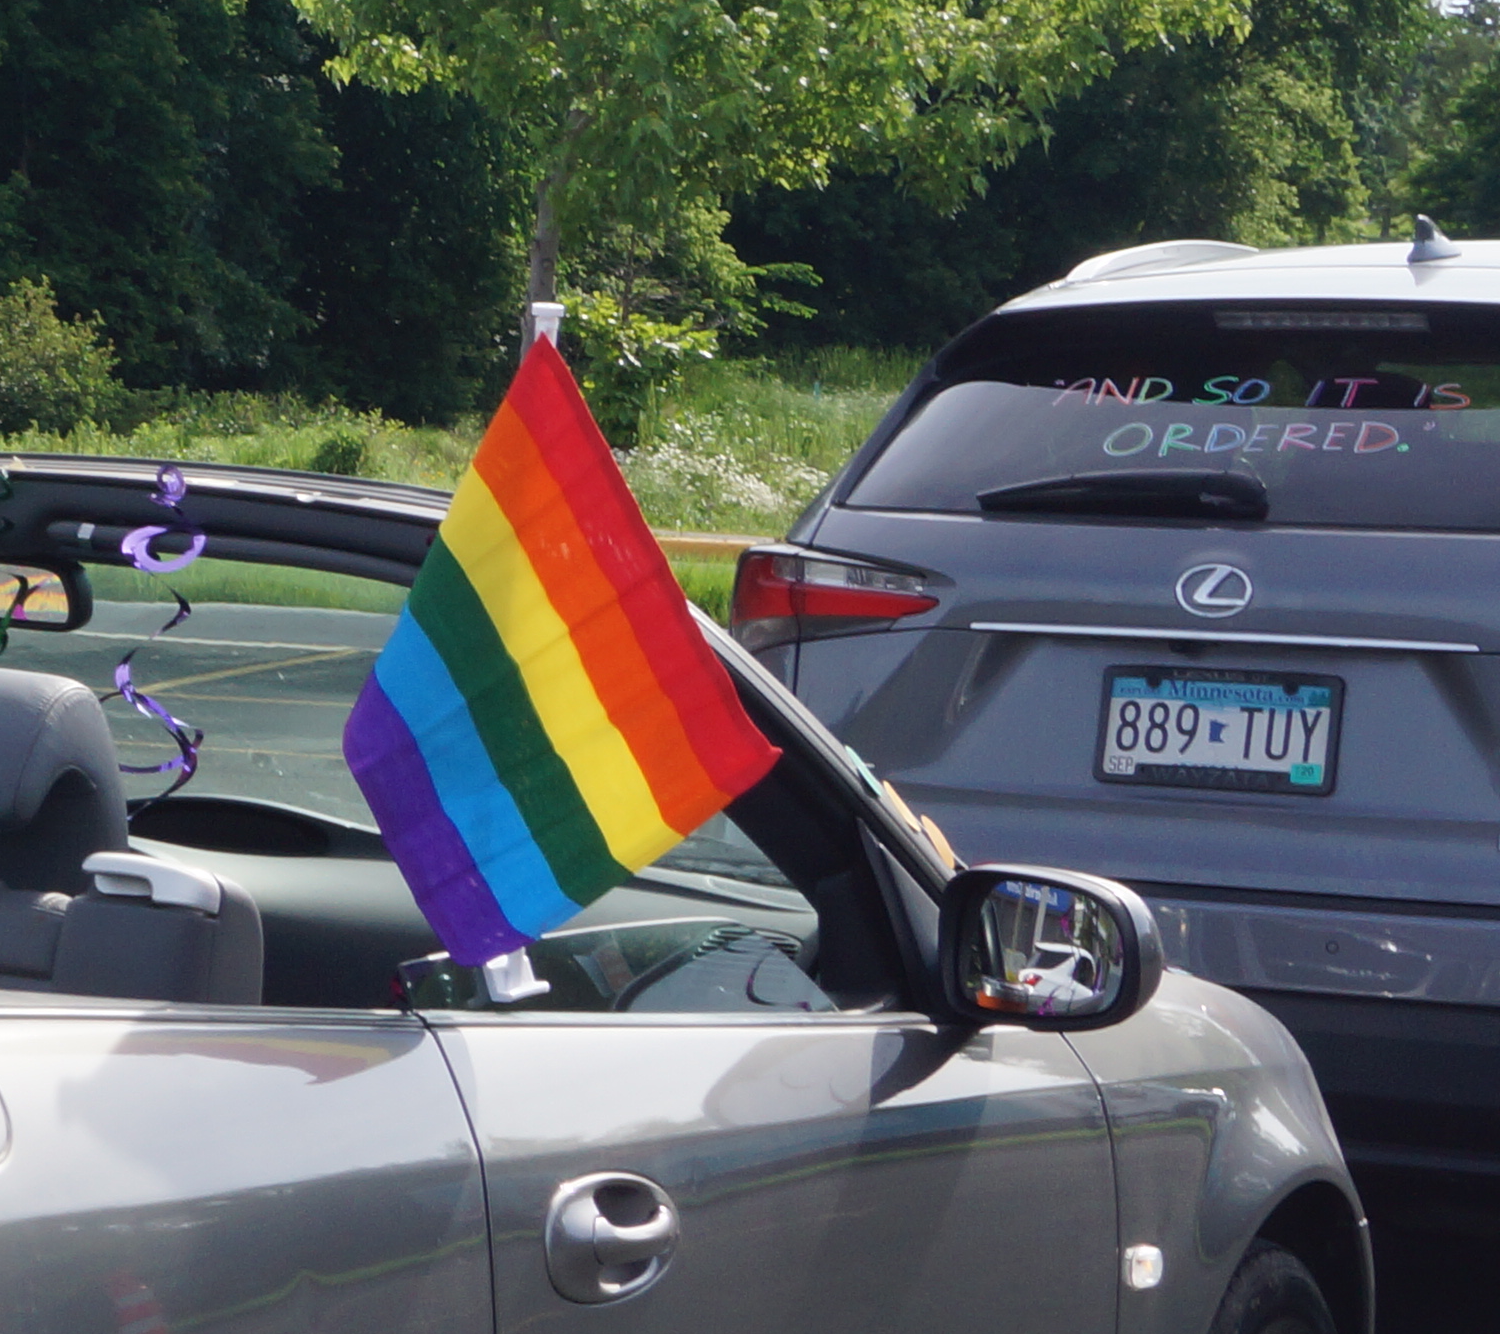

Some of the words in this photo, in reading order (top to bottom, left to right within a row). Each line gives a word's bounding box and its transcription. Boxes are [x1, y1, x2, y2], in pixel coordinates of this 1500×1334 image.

[1192, 375, 1270, 405] SO
[1304, 377, 1379, 408] IT
[1413, 382, 1471, 410] IS
[1115, 700, 1200, 754] 889
[1240, 706, 1322, 763] TUY
[1108, 755, 1134, 772] SEP
